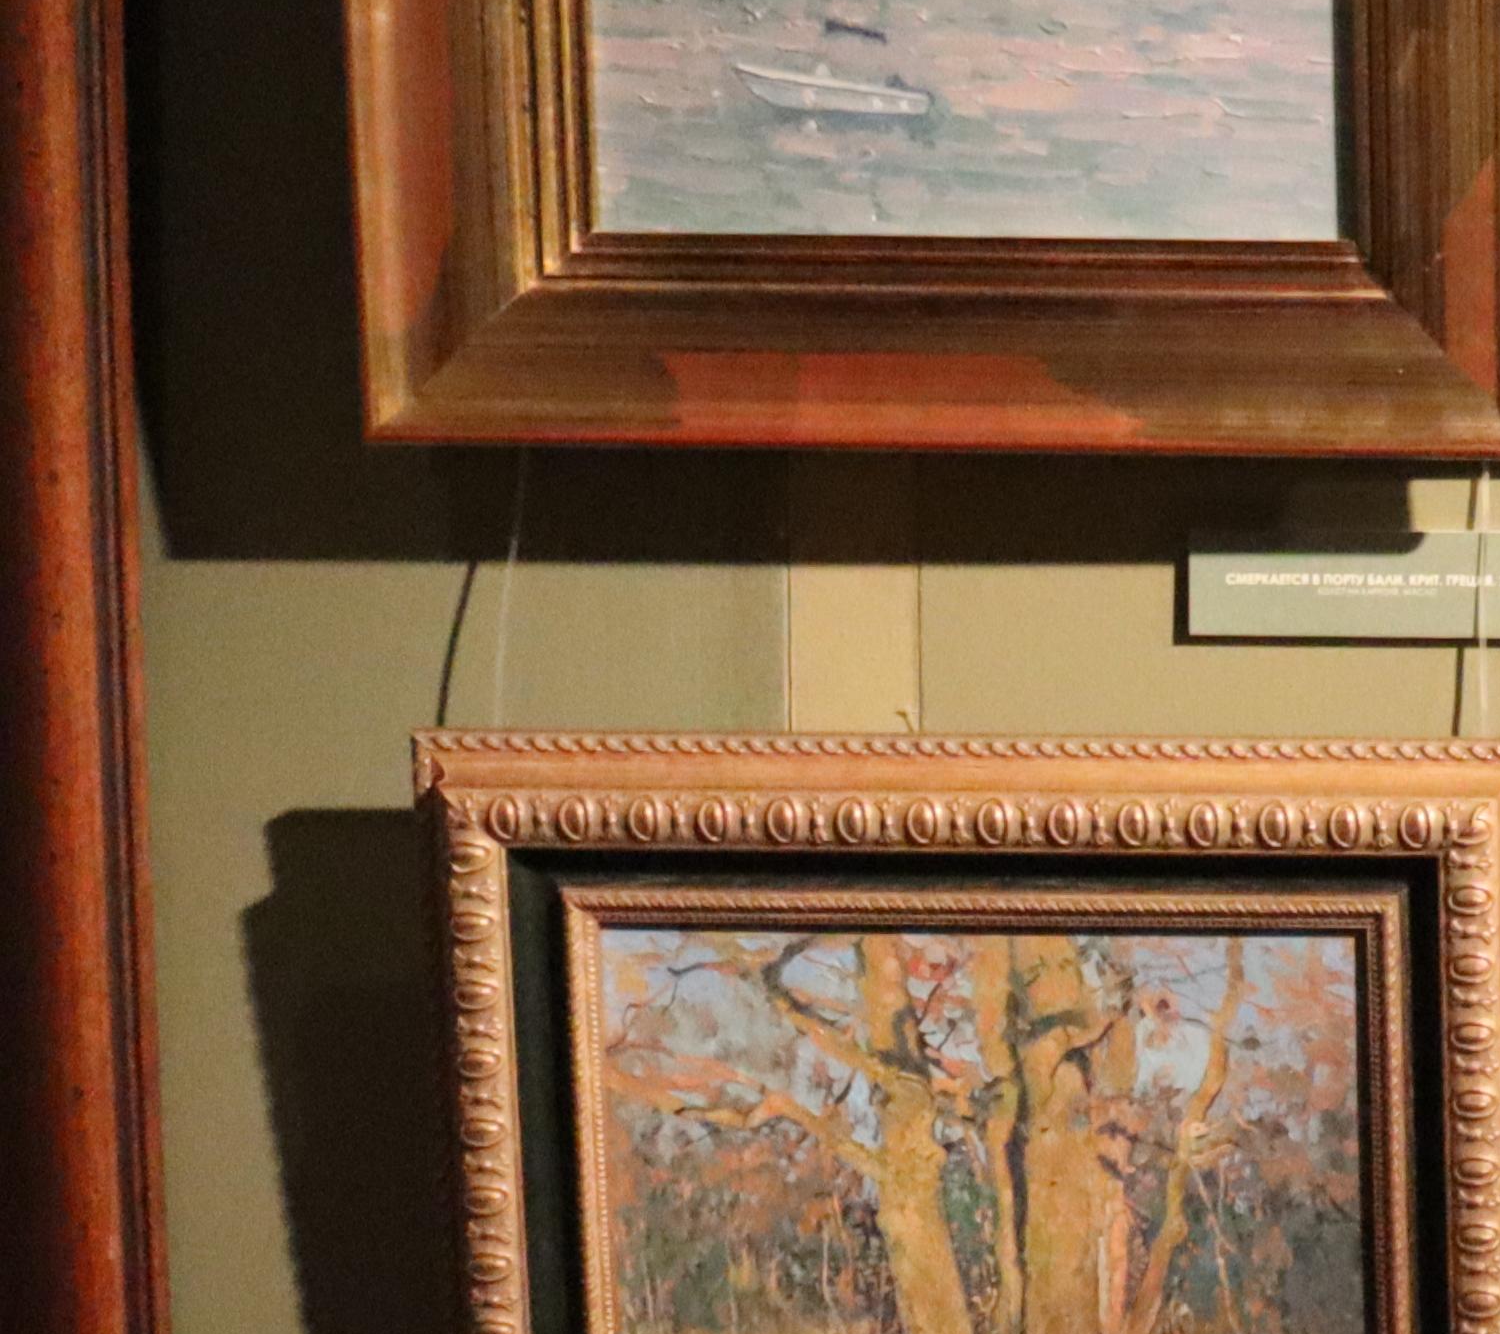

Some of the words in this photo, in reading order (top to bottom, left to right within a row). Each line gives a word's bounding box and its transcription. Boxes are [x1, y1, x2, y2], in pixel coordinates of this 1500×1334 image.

[1225, 572, 1310, 586] СМЕРКАЕТСЯ
[1323, 573, 1365, 586] ПОРТУ
[1408, 574, 1443, 587] КРИТ.
